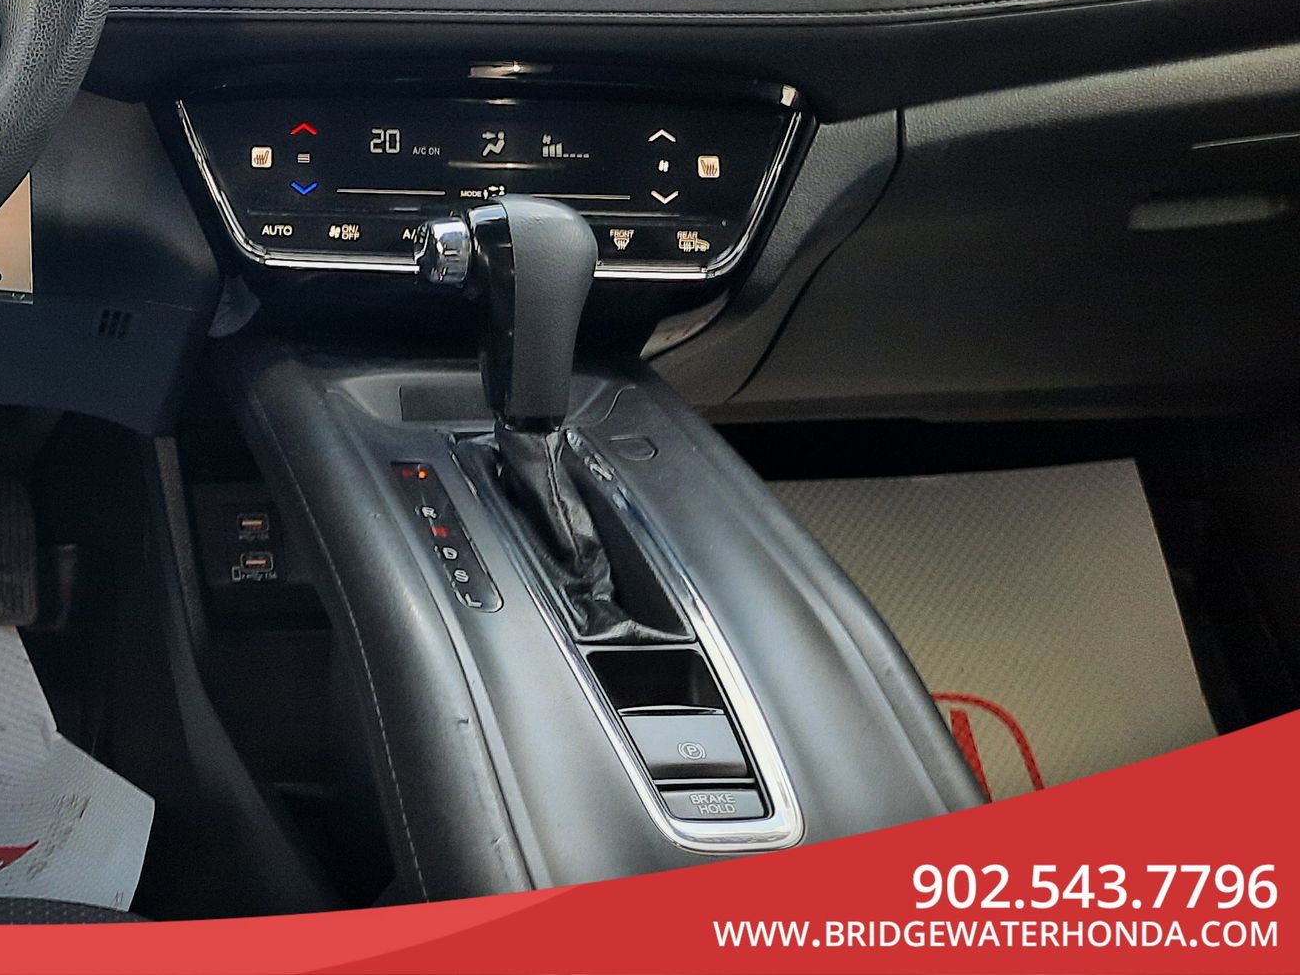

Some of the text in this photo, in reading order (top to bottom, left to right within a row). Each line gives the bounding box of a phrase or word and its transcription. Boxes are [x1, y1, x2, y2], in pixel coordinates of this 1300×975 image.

[369, 128, 401, 154] 20
[412, 146, 441, 156] A/C ON
[460, 190, 482, 198] MODE
[262, 225, 294, 236] AUTO
[690, 793, 736, 805] BRAKE
[699, 804, 736, 815] HOLD
